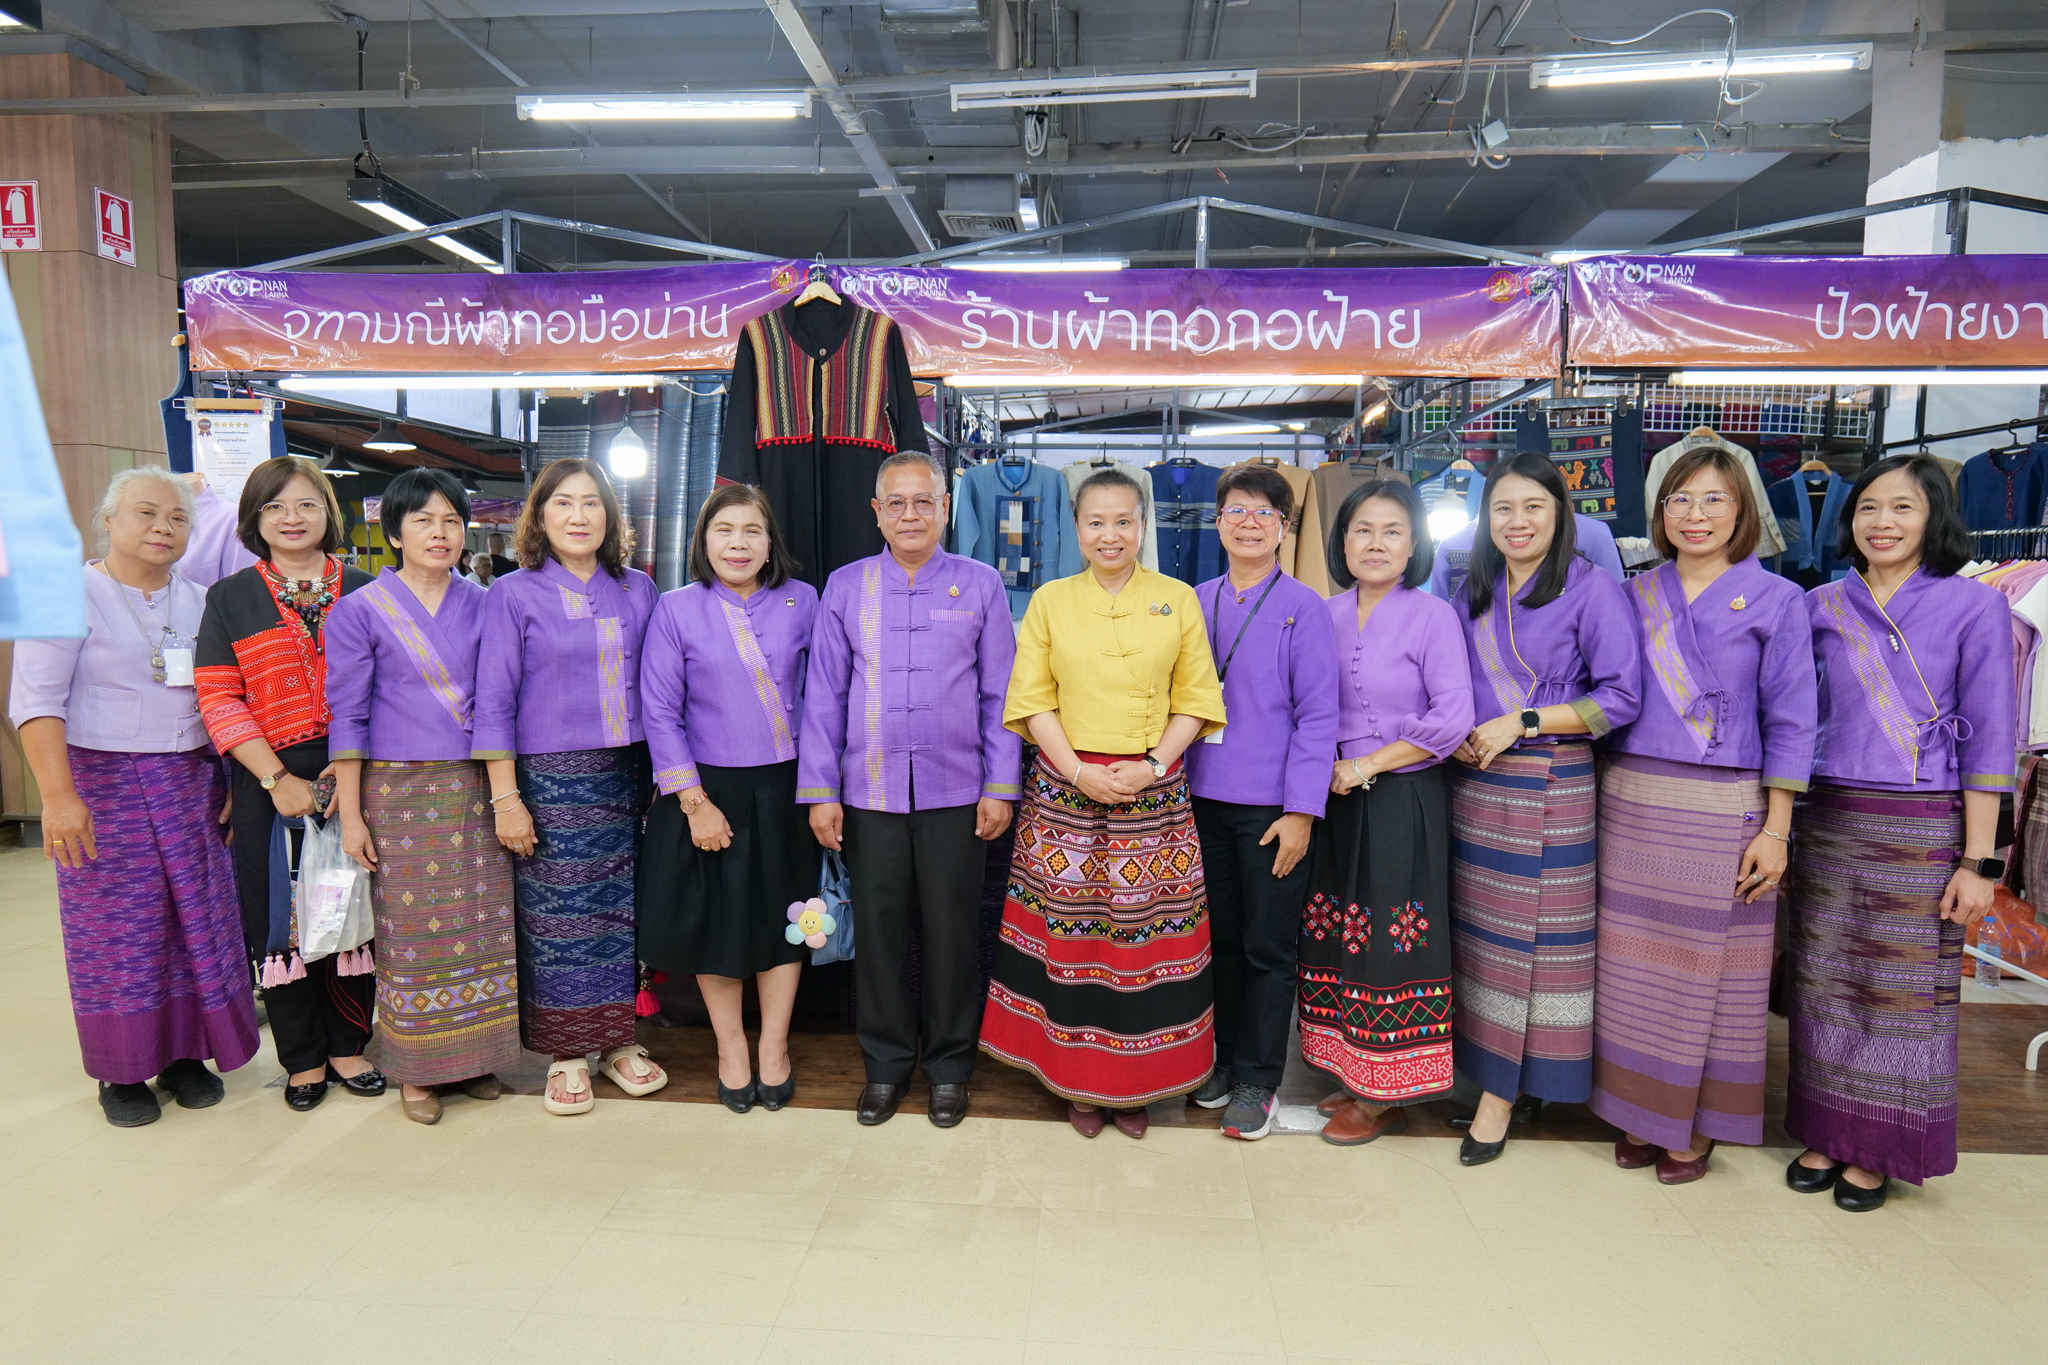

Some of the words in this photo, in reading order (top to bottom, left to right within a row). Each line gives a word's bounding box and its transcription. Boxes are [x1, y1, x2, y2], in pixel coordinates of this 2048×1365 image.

[1664, 264, 1696, 277] NAN
[264, 280, 289, 292] NAN
[841, 274, 919, 297] OTOP
[919, 278, 948, 290] NAN
[1663, 276, 1694, 284] LANNA
[919, 289, 948, 297] LANNA
[283, 291, 728, 357] จุฑามณีผ้าทอมือน่าน
[961, 289, 1421, 352] ร้านผ้าทอกอฝ้าย
